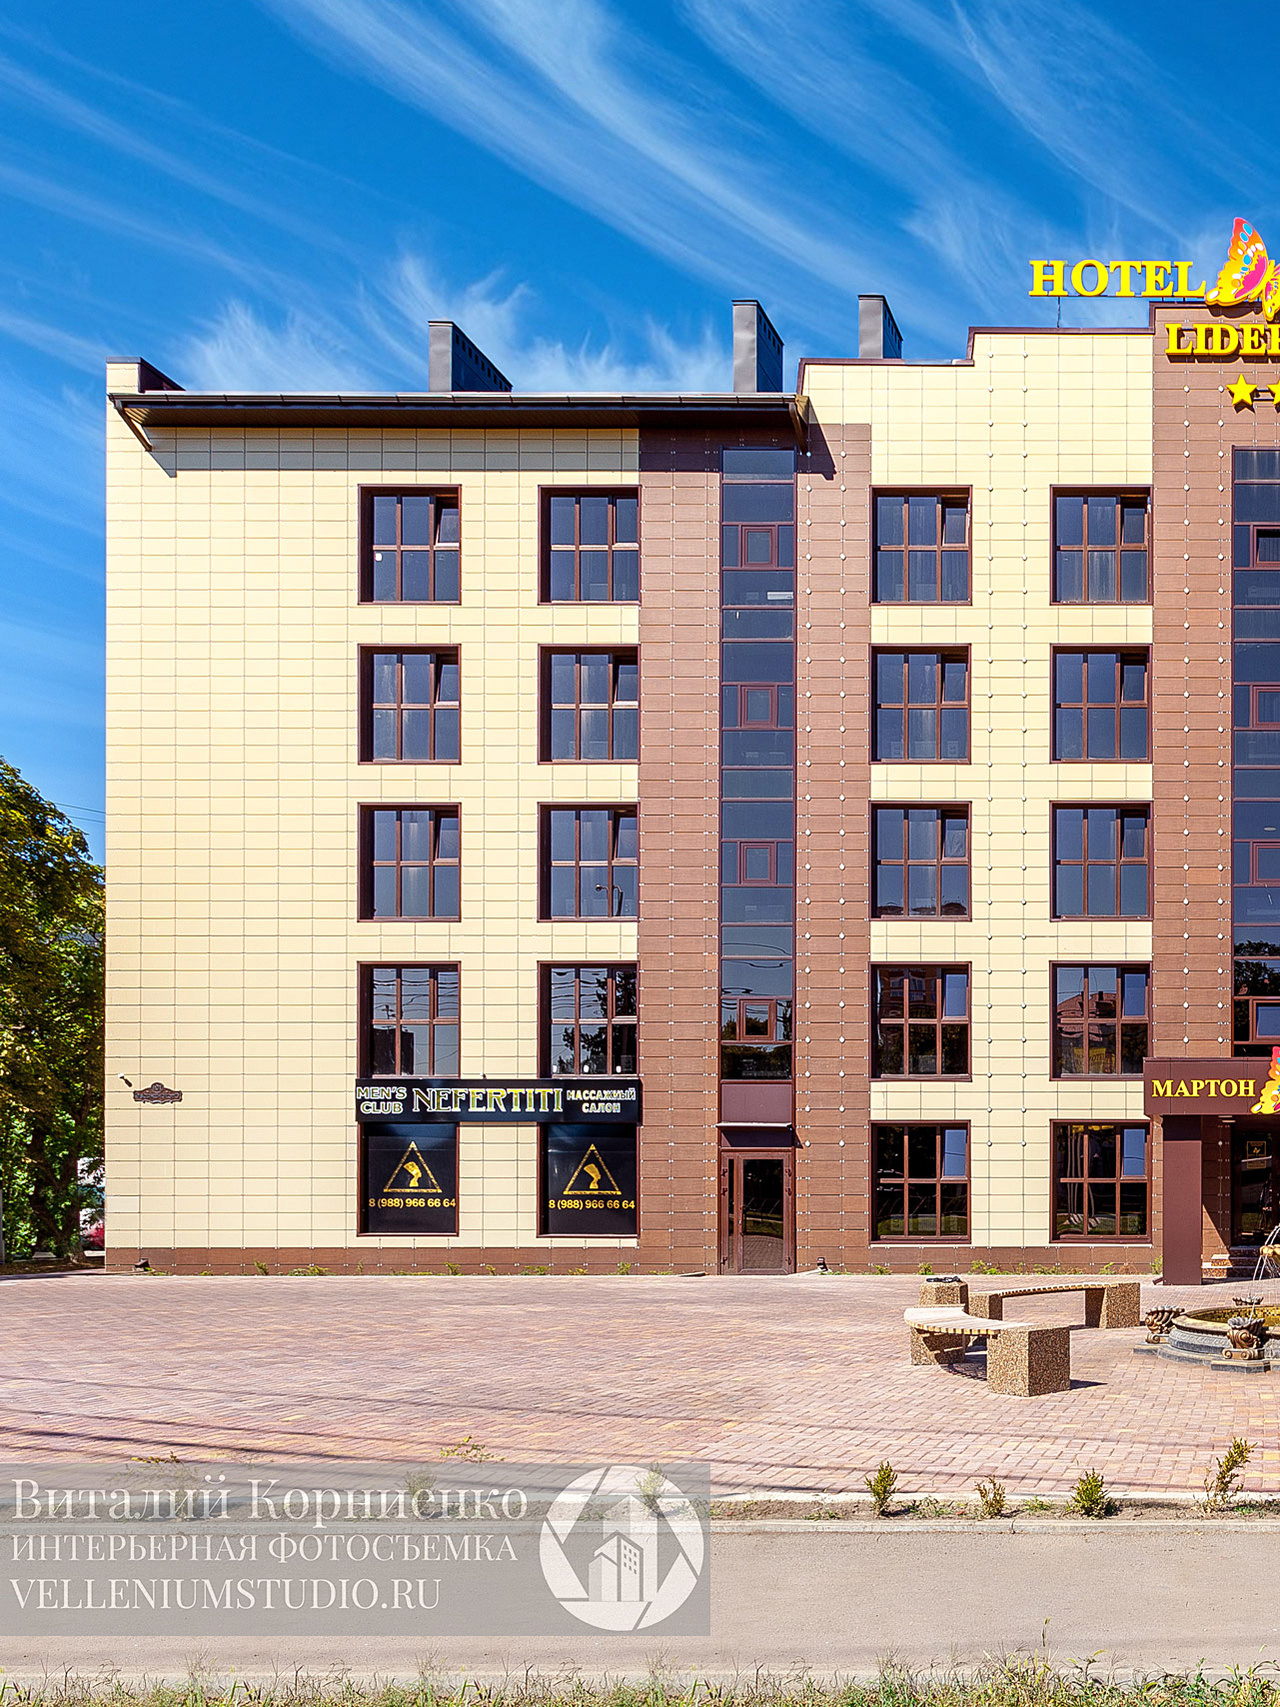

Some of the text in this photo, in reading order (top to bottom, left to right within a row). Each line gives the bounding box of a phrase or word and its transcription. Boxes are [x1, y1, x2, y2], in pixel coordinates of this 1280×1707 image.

[1029, 260, 1206, 298] HOTEL
[356, 1087, 407, 1099] MEN'S
[566, 1087, 636, 1101] МАССАЖНЫЙ
[1152, 1079, 1256, 1098] МАРТОН
[412, 1088, 563, 1112] NEFERTITI
[360, 1101, 403, 1114] CLUB
[582, 1102, 621, 1113] САЛОН
[368, 1198, 456, 1209] 8 (988) 966 66 64
[548, 1199, 635, 1210] 8 (988) 966 66 64
